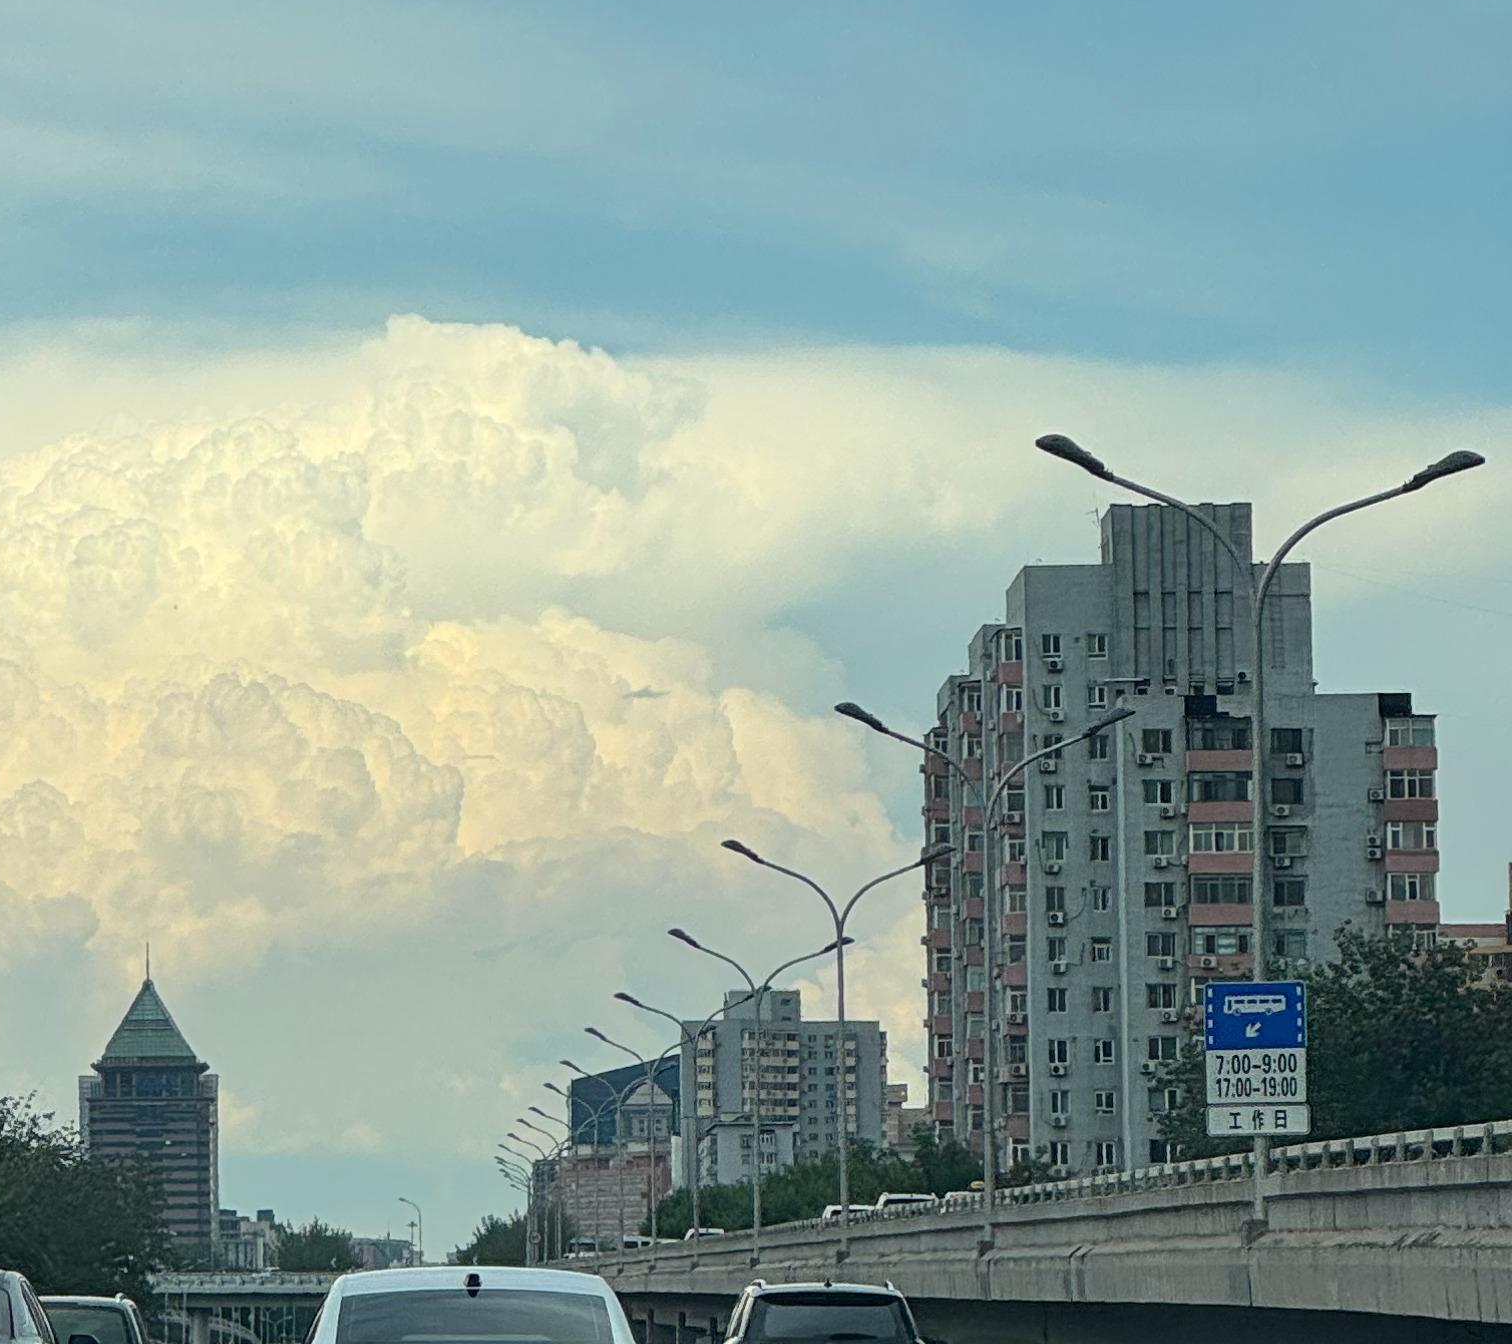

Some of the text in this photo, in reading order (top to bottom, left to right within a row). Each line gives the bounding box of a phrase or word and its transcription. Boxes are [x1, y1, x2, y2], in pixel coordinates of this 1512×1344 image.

[1215, 1053, 1297, 1075] 7:00-9:00
[1215, 1076, 1297, 1097] 17:00-19:00
[1228, 1109, 1287, 1130] 工作日
